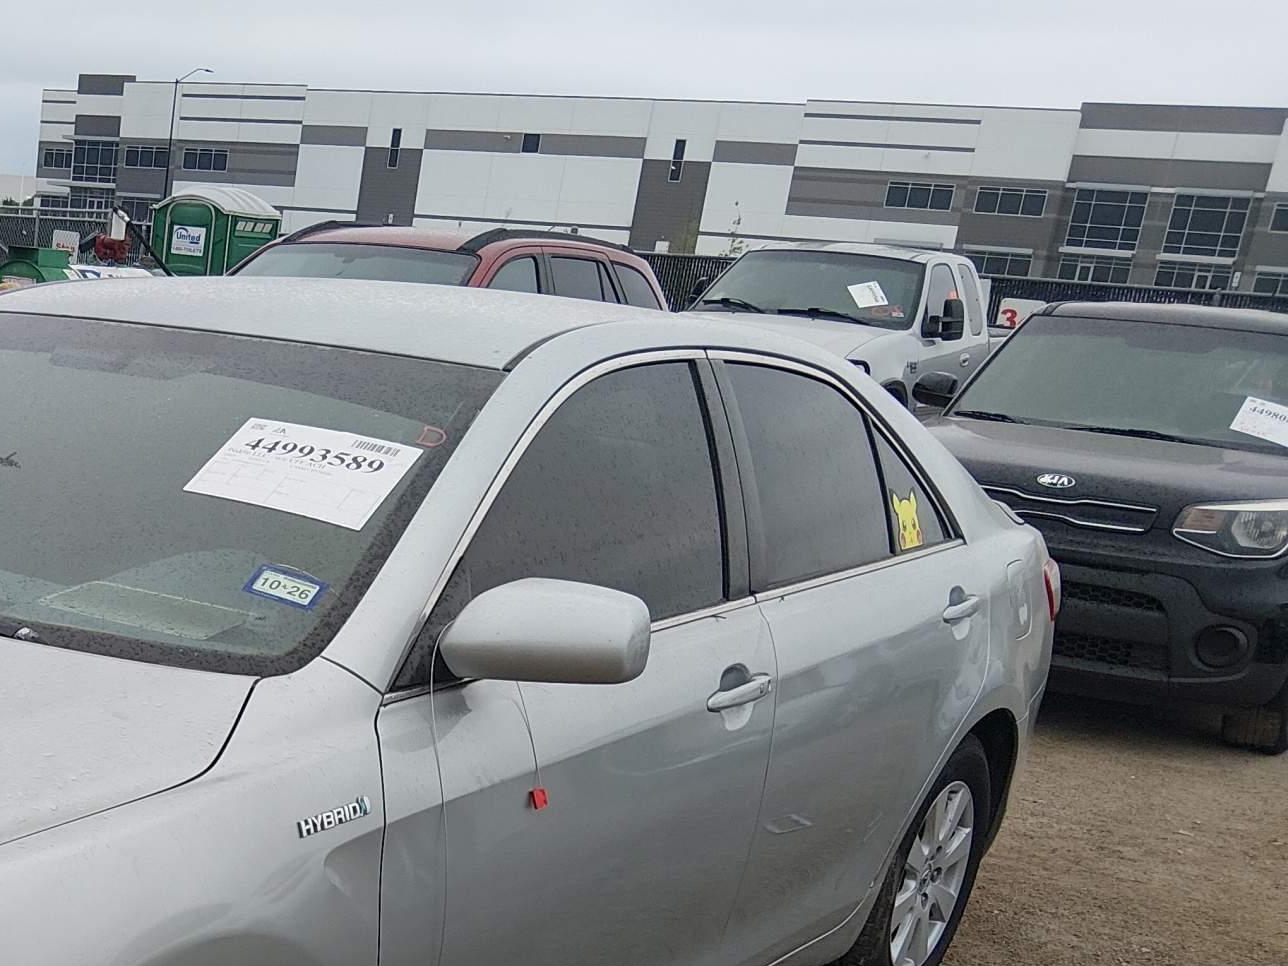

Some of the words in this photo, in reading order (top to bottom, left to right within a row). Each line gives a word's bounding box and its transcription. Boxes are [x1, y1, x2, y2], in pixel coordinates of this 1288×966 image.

[176, 231, 201, 242] United
[1249, 406, 1288, 423] 44980
[245, 437, 385, 474] 44993589
[1037, 474, 1075, 488] KIA
[261, 577, 281, 590] 10
[287, 586, 311, 600] 26
[298, 802, 361, 838] HYBRID
